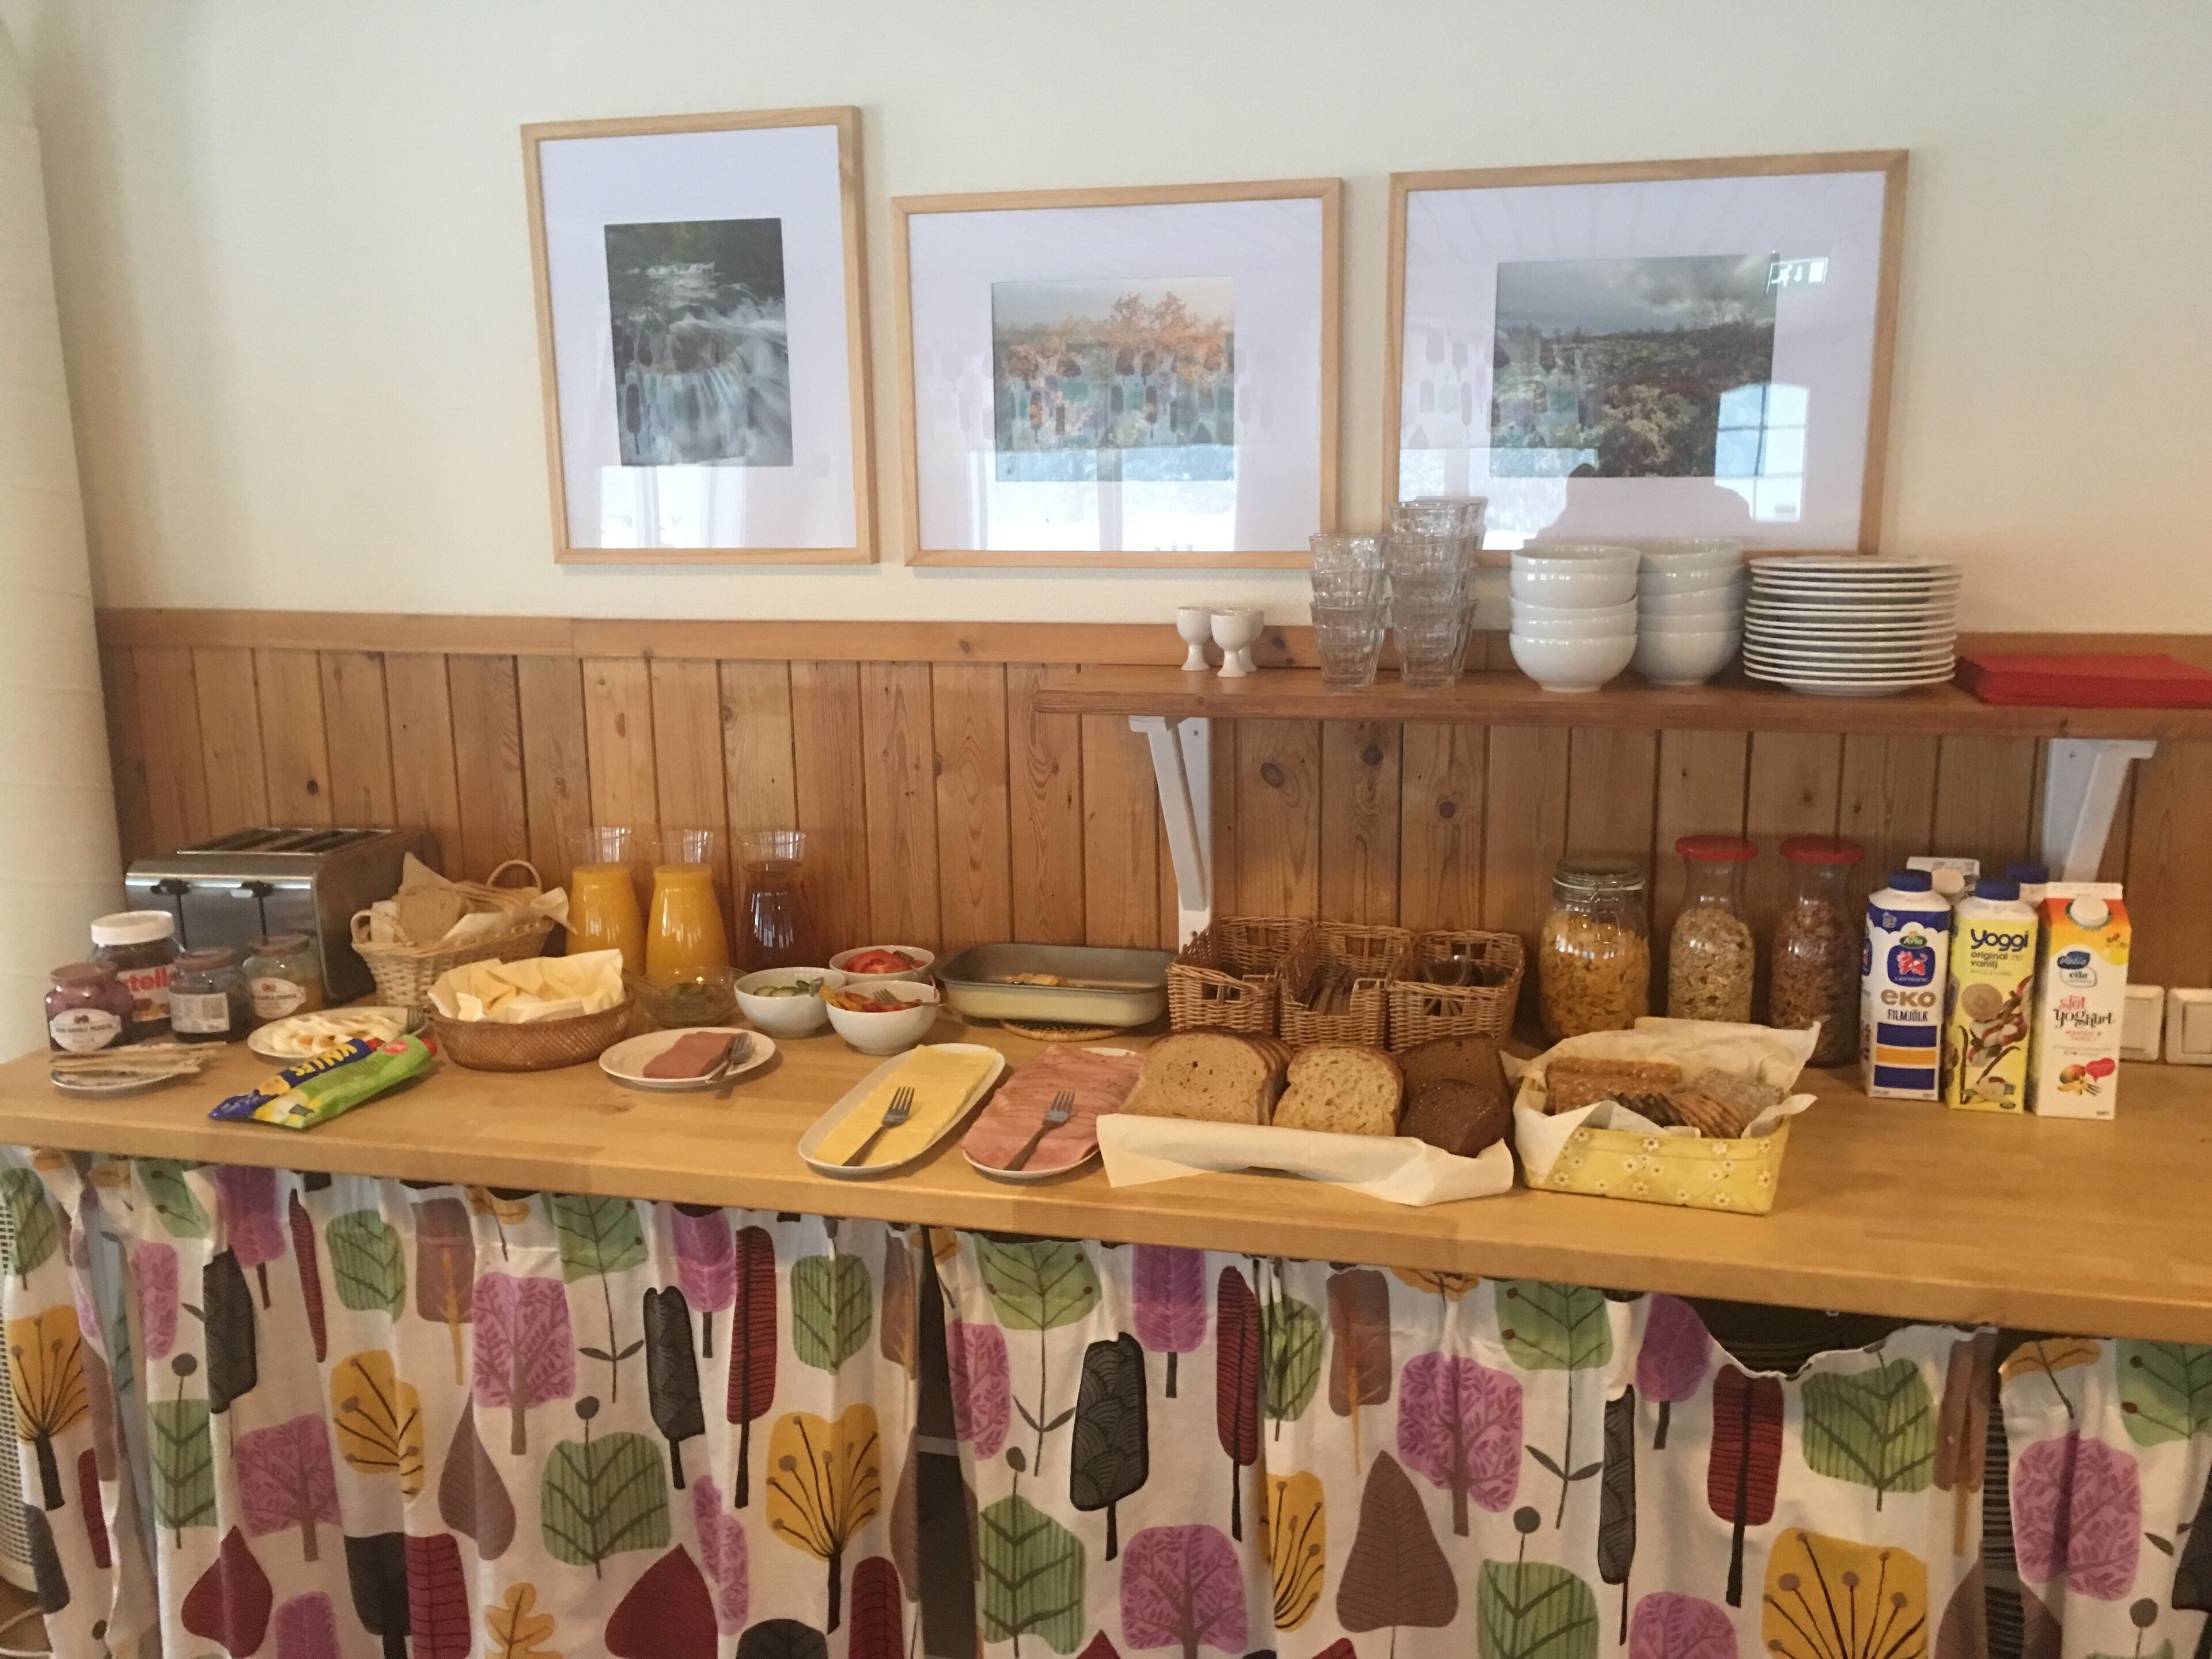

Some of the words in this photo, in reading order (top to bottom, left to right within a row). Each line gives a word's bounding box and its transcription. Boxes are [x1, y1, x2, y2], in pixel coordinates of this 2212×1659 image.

[1970, 929, 2029, 952] yoggi
[1970, 951, 2008, 960] original
[1970, 960, 1997, 969] vanilj
[1880, 989, 1936, 1007] eko
[1887, 1009, 1929, 1022] FILMJÖLK
[2053, 1009, 2116, 1028] yoghurt
